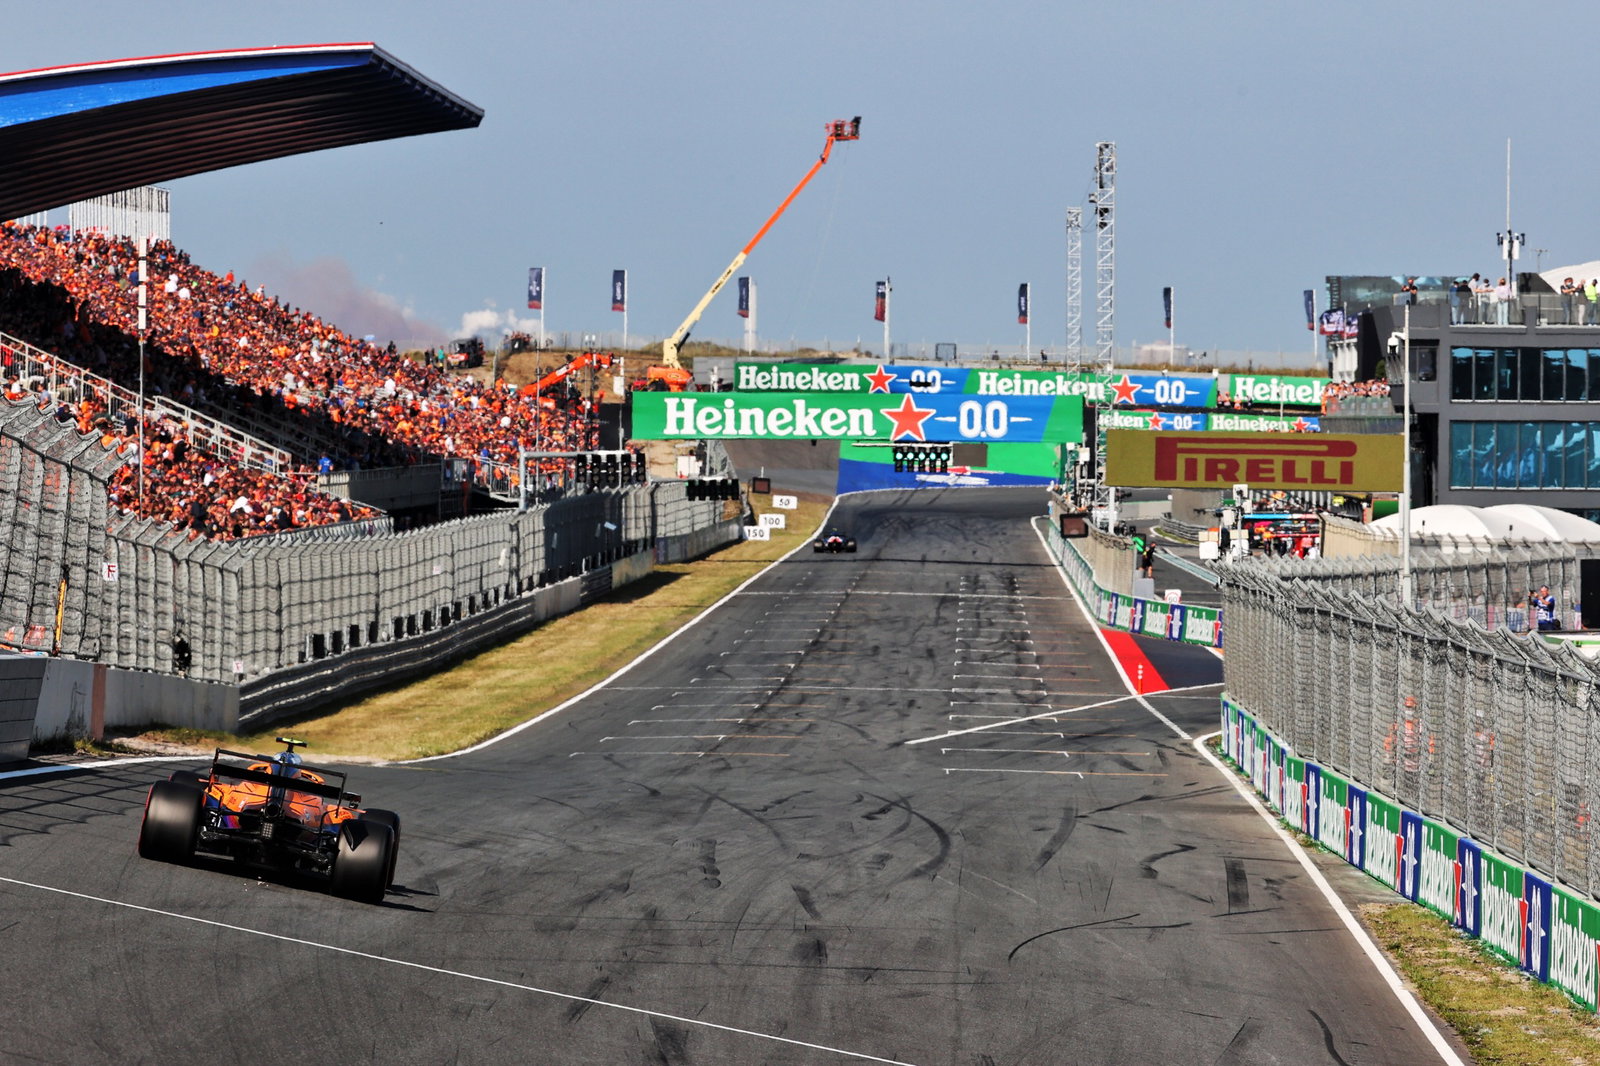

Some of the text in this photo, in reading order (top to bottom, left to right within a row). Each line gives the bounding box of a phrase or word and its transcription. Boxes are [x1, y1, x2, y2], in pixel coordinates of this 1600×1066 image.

[739, 366, 861, 391] Heineken
[977, 371, 1186, 404] Heineken 0.0
[664, 397, 1008, 438] Heineken 0.0
[1211, 414, 1289, 432] Heineken
[1155, 437, 1357, 485] PIRELLI
[779, 498, 790, 506] 50
[764, 516, 780, 525] 100
[747, 529, 764, 538] 150
[1550, 892, 1596, 1007] Heineken
